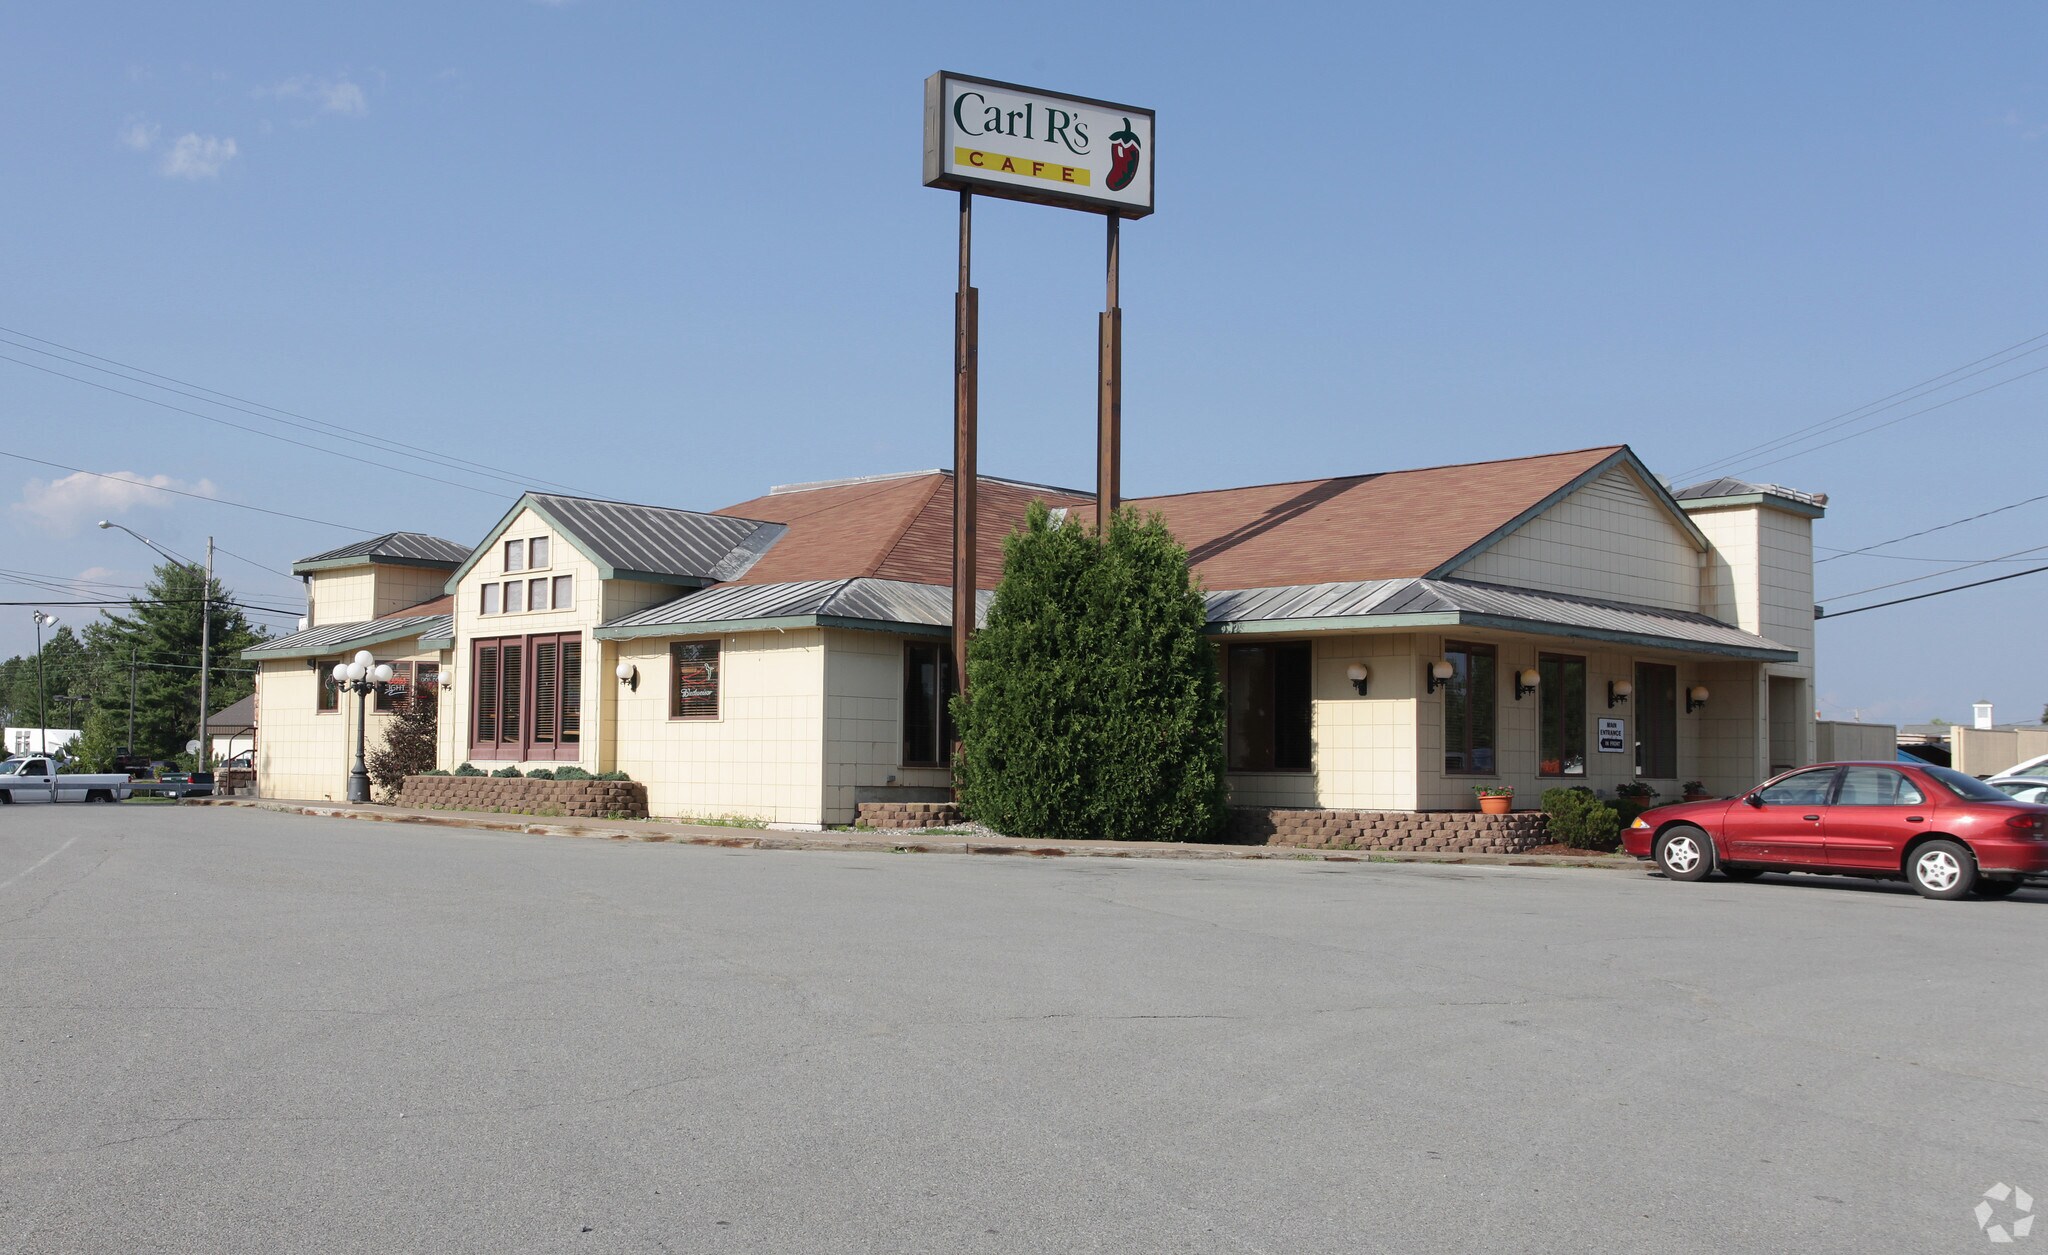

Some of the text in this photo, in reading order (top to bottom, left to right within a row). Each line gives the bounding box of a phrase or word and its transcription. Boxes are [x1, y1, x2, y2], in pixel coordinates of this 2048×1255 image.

[953, 92, 1091, 155] Carl R's
[969, 151, 1075, 183] CAFE
